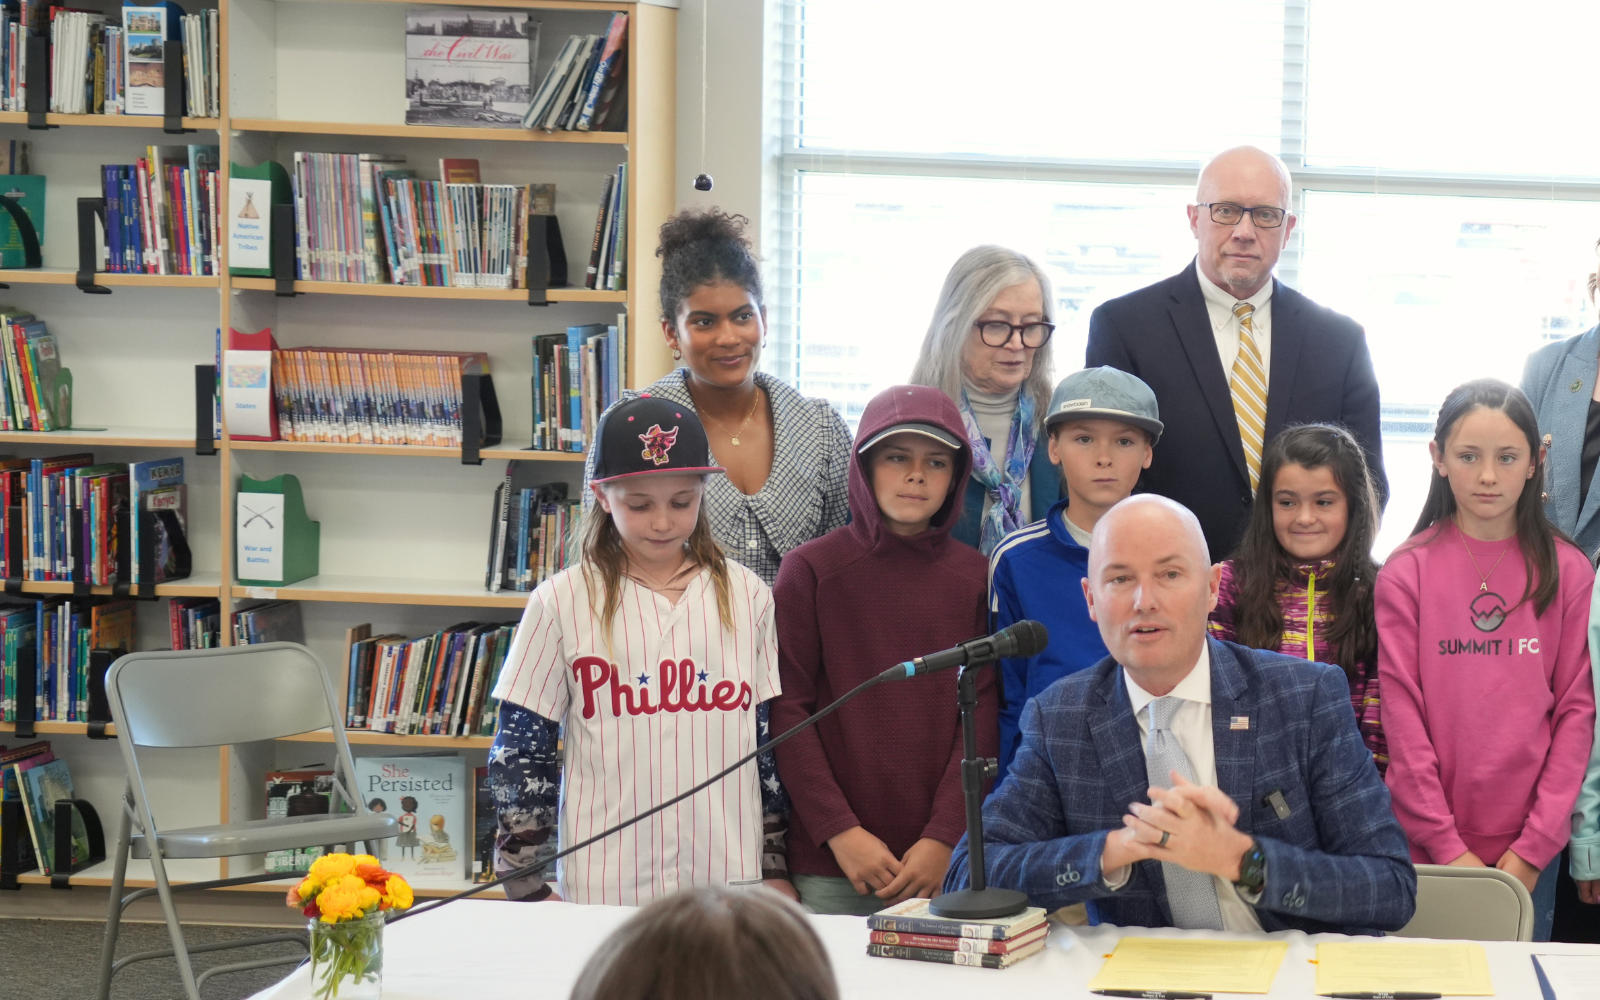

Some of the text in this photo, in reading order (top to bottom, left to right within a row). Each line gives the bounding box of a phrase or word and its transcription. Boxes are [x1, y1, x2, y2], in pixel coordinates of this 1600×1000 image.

[420, 41, 444, 58] the
[447, 34, 482, 64] Civil
[484, 44, 514, 60] War
[237, 222, 260, 230] Native
[232, 233, 264, 241] American
[238, 243, 258, 251] Tribes
[150, 463, 181, 481] KENYA
[153, 496, 175, 508] Kenya
[246, 556, 270, 564] Battles
[1479, 582, 1488, 591] A
[1438, 638, 1502, 656] SUMMIT
[1518, 638, 1540, 654] FC
[572, 655, 752, 719] Phillies
[382, 764, 410, 778] She
[368, 774, 454, 792] Persisted
